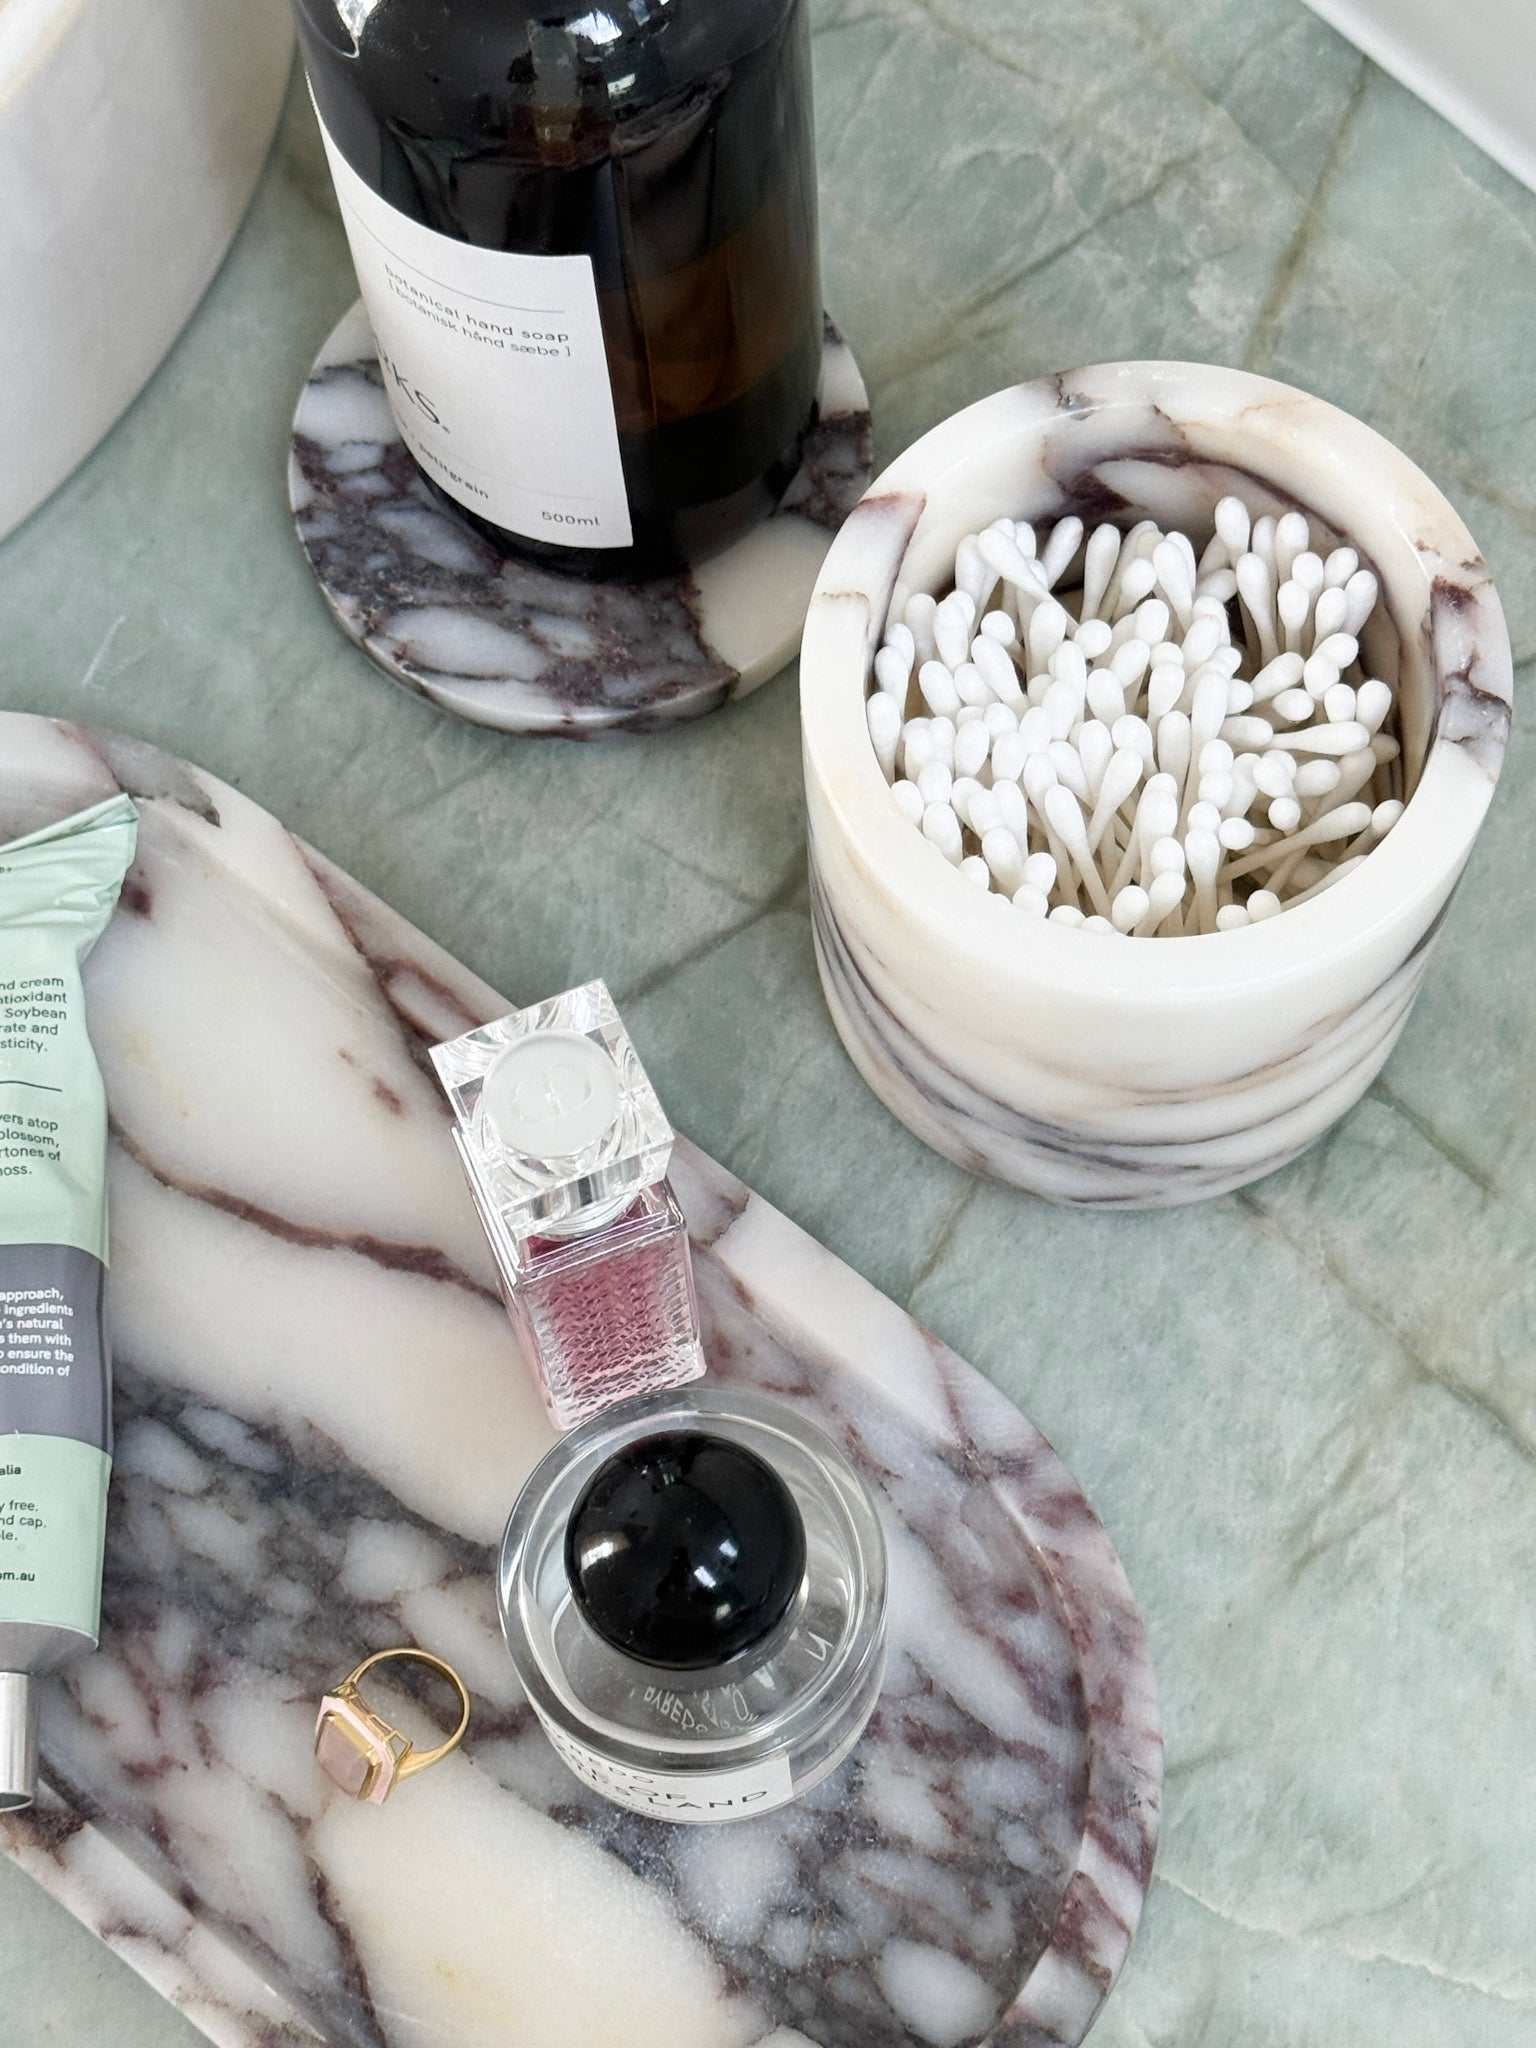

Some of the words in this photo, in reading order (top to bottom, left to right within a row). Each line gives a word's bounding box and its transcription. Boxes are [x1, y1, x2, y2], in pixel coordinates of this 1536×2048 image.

[385, 264, 460, 320] botanical
[466, 314, 513, 336] hand
[521, 330, 569, 343] soap
[541, 511, 599, 526] 500ml
[20, 977, 64, 989] cream
[5, 1006, 67, 1020] Soybean
[32, 1024, 58, 1035] and
[0, 1038, 48, 1053] sticity.
[28, 1118, 58, 1132] atop
[48, 1151, 60, 1161] of
[0, 1288, 64, 1303] approach,
[4, 1302, 73, 1317] ingredients
[17, 1318, 63, 1330] natural
[8, 1333, 41, 1344] them
[45, 1334, 71, 1346] with
[7, 1350, 51, 1359] ensure
[54, 1349, 74, 1362] the
[57, 1365, 70, 1376] of
